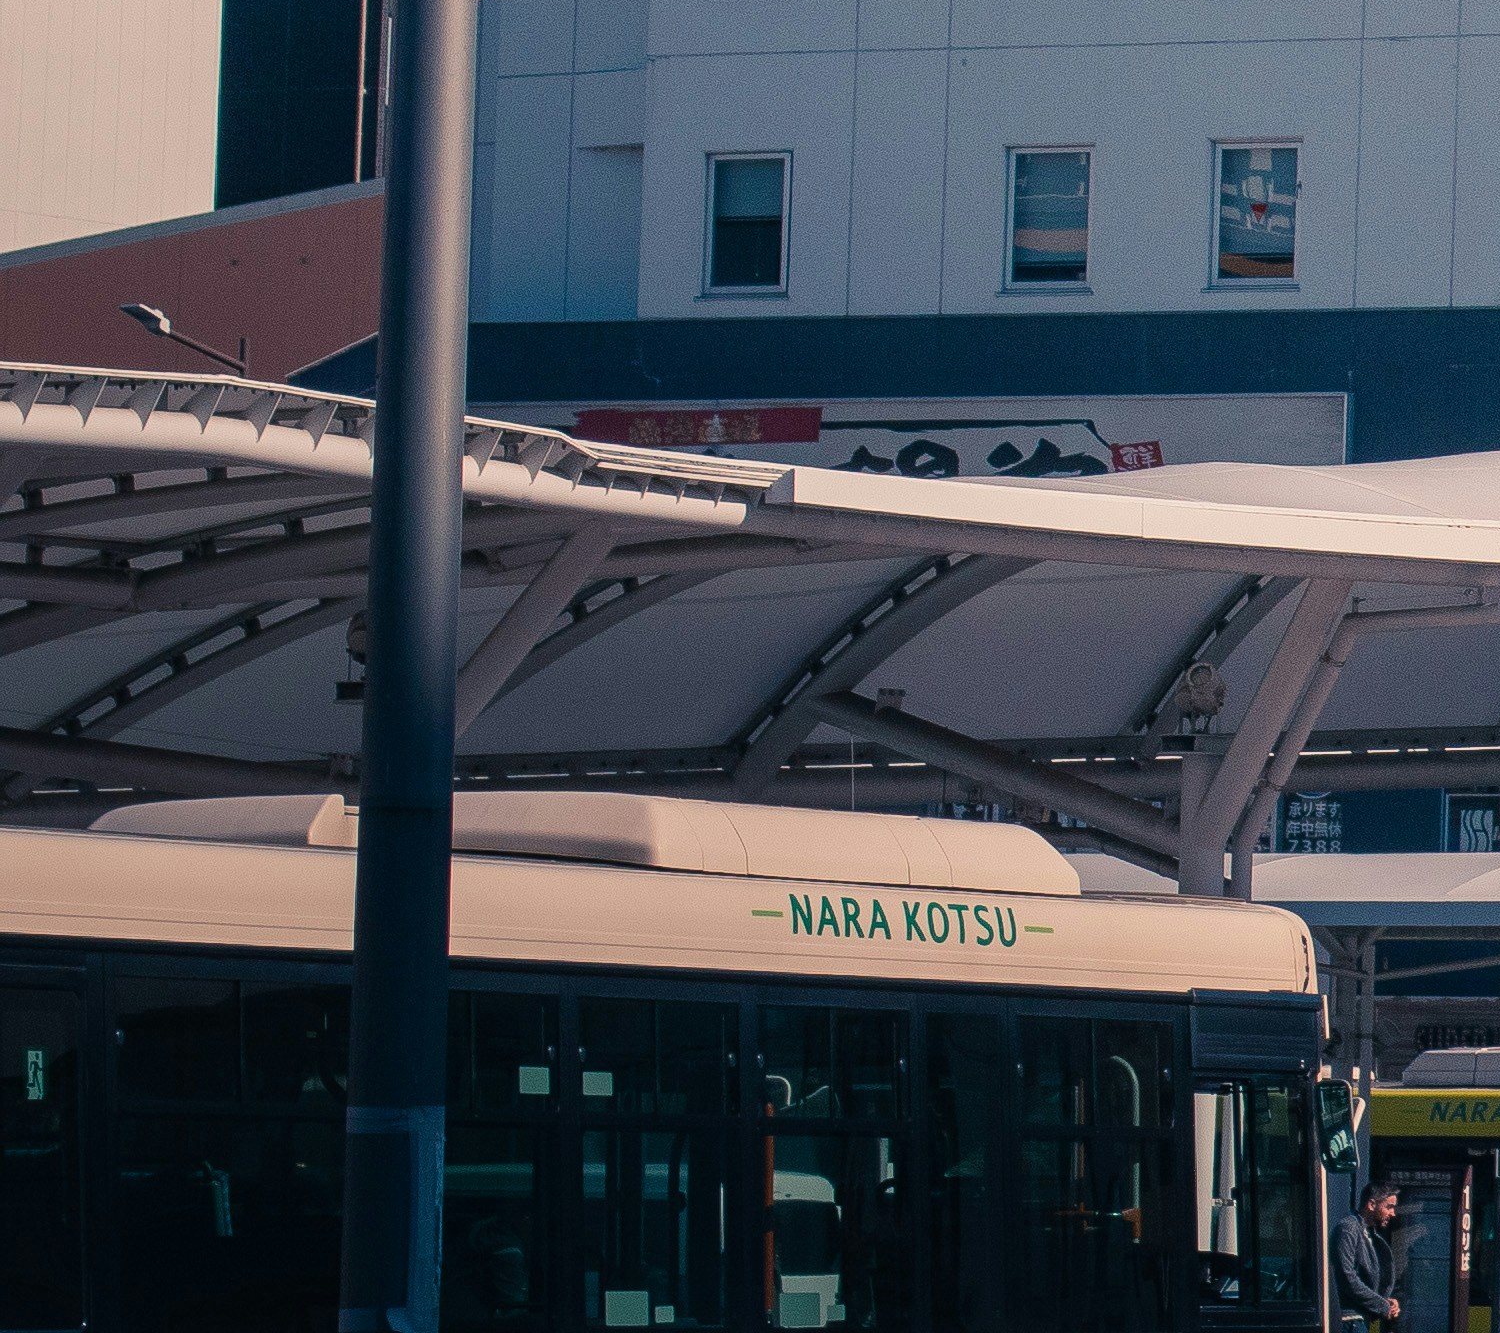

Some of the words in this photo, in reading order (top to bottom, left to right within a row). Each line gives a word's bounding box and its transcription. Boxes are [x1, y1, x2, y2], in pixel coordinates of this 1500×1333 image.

[1289, 802, 1342, 817] 承ります
[1286, 820, 1342, 837] 年中無休
[791, 893, 892, 939] NARA
[904, 902, 1017, 947] KOTSU
